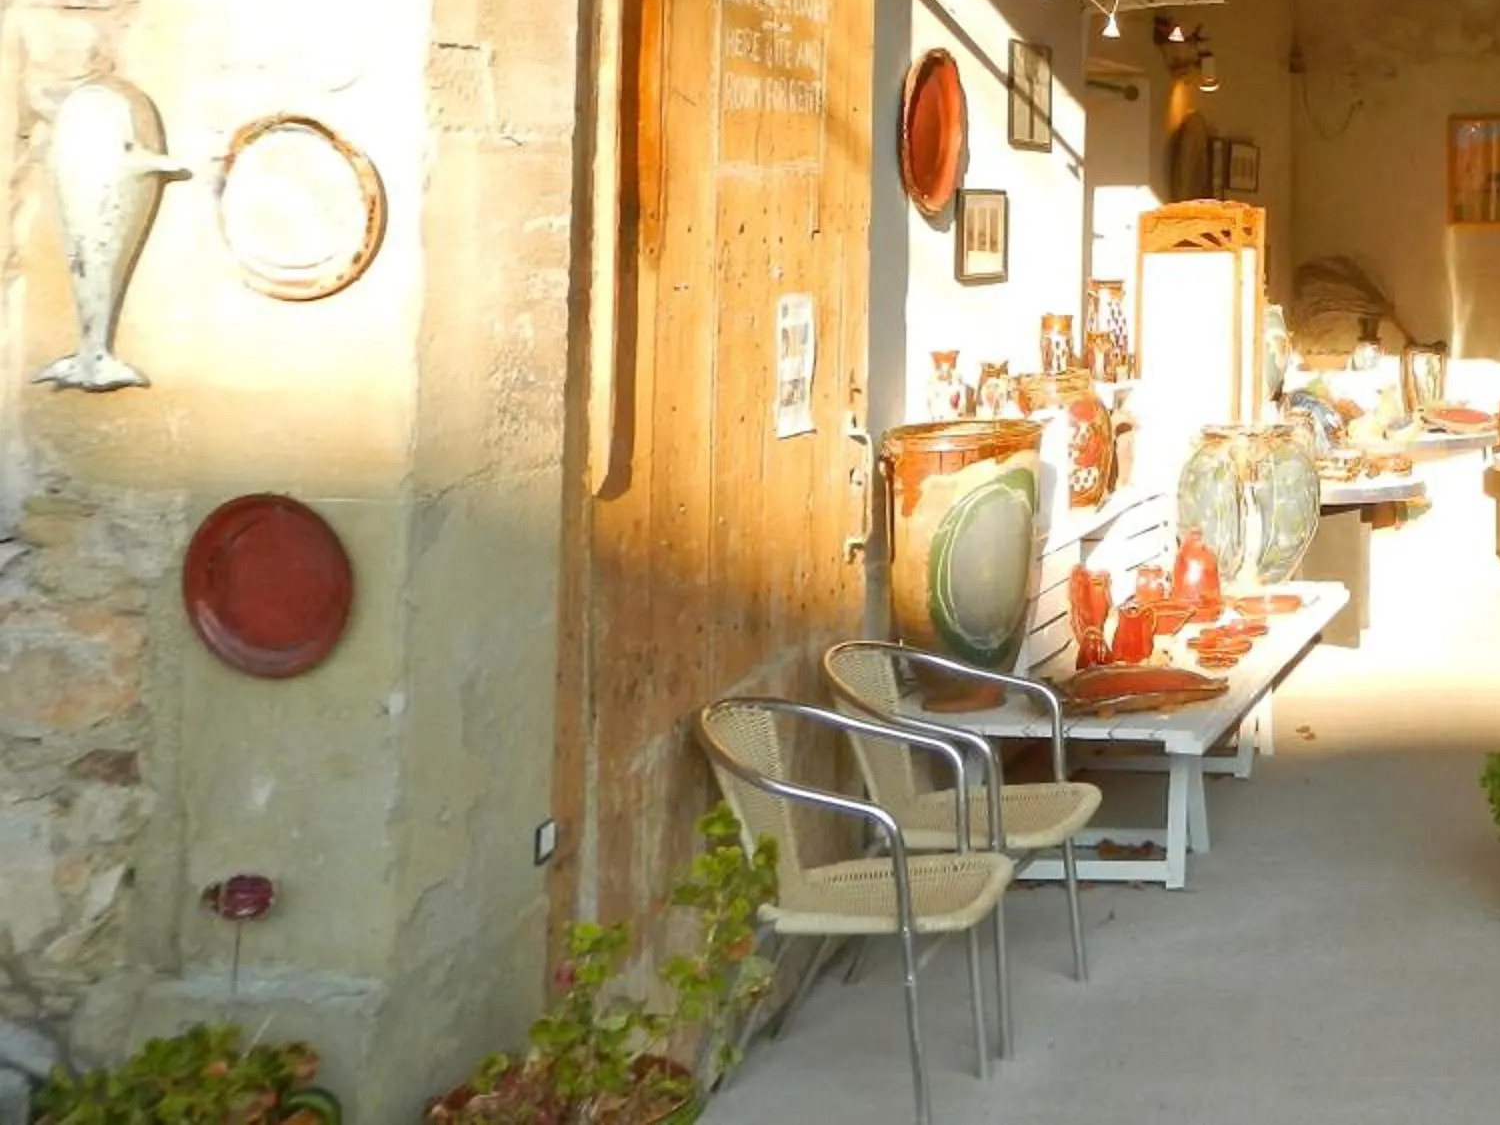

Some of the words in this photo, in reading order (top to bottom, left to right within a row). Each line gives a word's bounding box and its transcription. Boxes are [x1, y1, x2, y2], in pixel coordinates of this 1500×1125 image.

[725, 28, 761, 62] HERE
[795, 39, 821, 73] AND
[724, 71, 762, 114] ROOM
[765, 76, 788, 112] FOR
[789, 78, 823, 115] RENT
